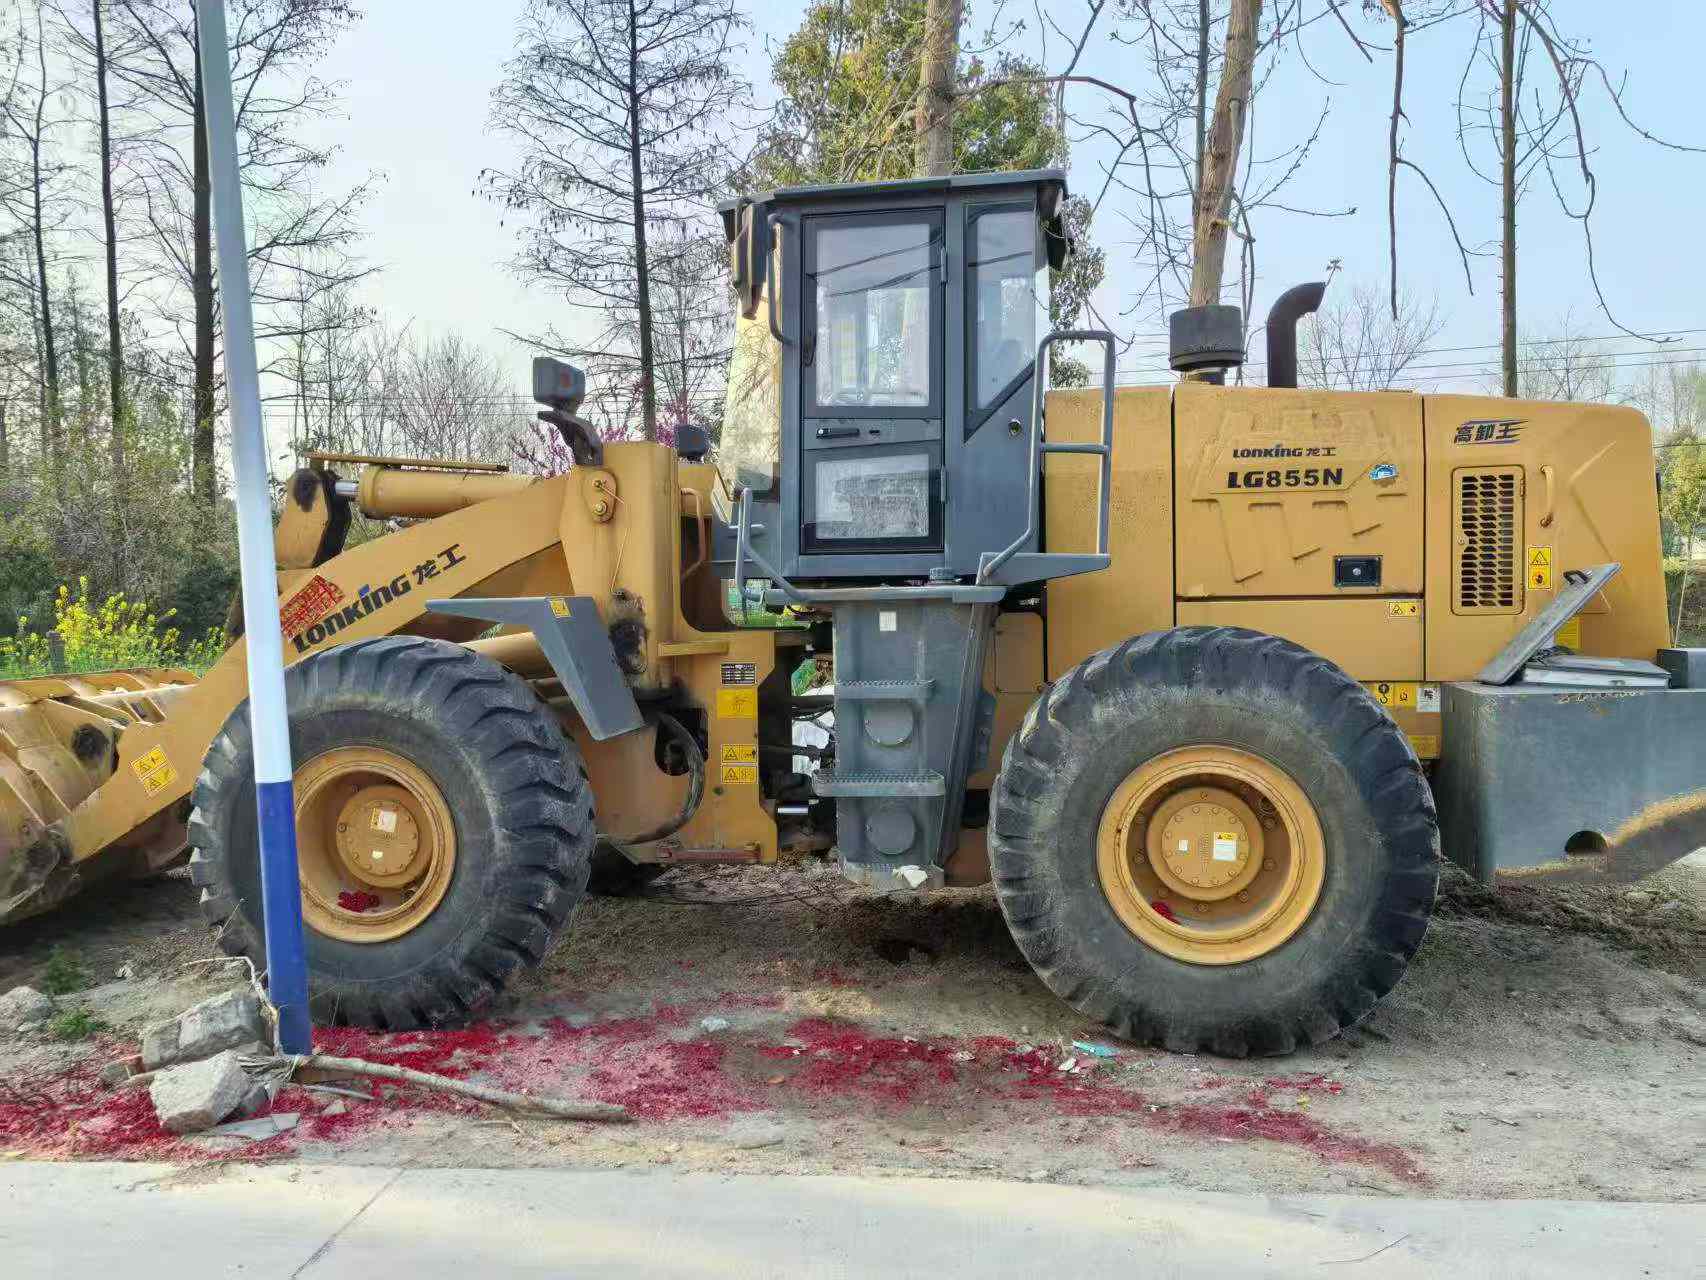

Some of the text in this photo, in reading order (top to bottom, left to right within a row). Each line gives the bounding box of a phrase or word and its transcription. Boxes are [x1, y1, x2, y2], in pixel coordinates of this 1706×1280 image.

[1305, 446, 1336, 457] 龙工
[1227, 467, 1343, 489] LG855N
[411, 543, 467, 585] 龙工
